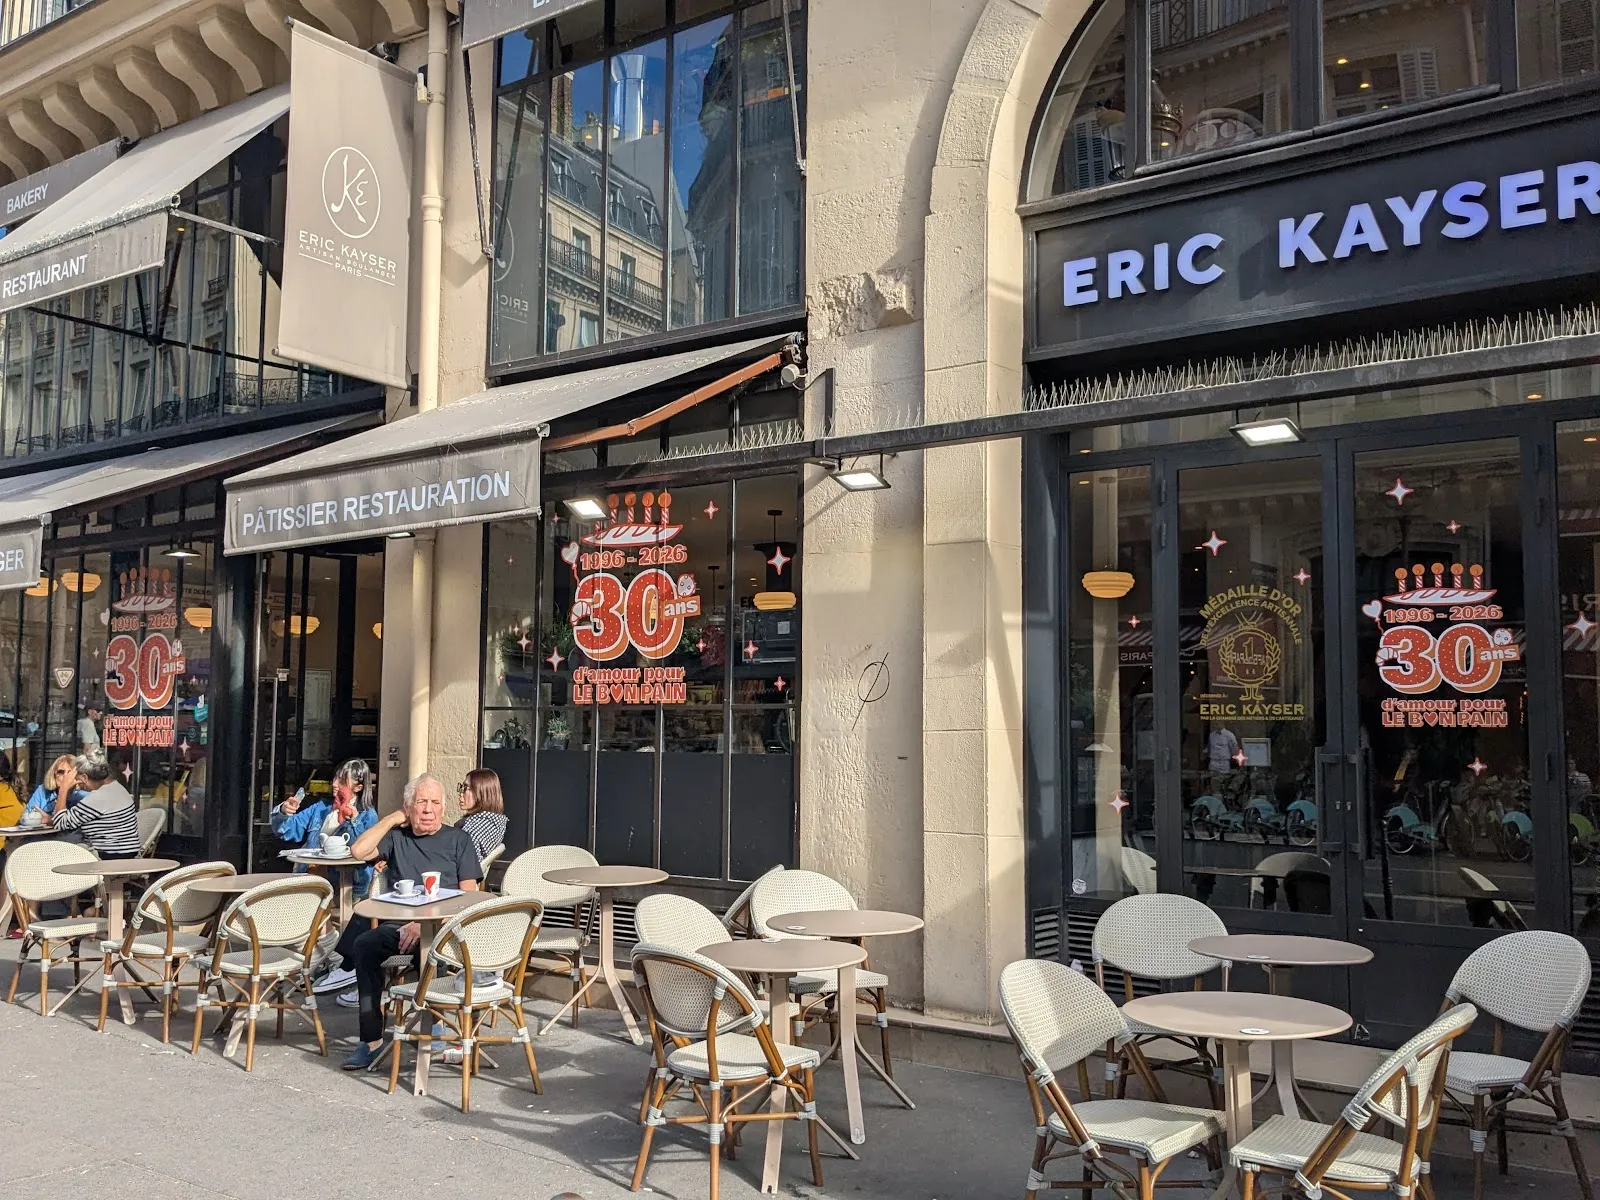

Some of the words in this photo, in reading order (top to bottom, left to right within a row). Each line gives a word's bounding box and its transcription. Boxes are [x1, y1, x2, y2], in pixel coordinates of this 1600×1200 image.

[7, 183, 49, 214] BAKERY
[1062, 232, 1226, 307] ERIC
[1278, 160, 1600, 268] KAYSER
[299, 230, 335, 252] ERIC
[341, 244, 397, 273] KAYSER
[299, 243, 341, 261] ARTISAN
[346, 259, 396, 280] BOULANGER
[2, 254, 88, 298] RESTAURANT
[335, 263, 362, 277] PARIS
[242, 500, 338, 536] PÂTISSIER
[343, 470, 510, 522] RESTAURATION
[579, 548, 626, 571] 1996
[638, 544, 688, 565] 2026
[573, 568, 685, 661] 30
[664, 598, 699, 617] ans
[1199, 584, 1268, 619] MÉDAILLE
[1384, 608, 1434, 623] 1996
[1449, 604, 1503, 621] 2026
[111, 616, 139, 632] 1996
[148, 613, 177, 629] 2026
[1260, 600, 1303, 645] ARTISANALE
[104, 633, 174, 710] 30
[162, 660, 184, 674] ans
[1379, 622, 1502, 694] 30
[1480, 648, 1517, 661] ans
[643, 666, 686, 685] pour
[573, 684, 594, 703] LE
[640, 682, 687, 704] PAIN
[1460, 699, 1507, 712] pour
[148, 715, 174, 731] pour
[1200, 703, 1237, 715] ERIC
[1243, 703, 1304, 715] KAYSER
[1382, 712, 1405, 727] LE
[1457, 711, 1508, 728] PAIN
[103, 729, 117, 745] LE
[145, 729, 175, 747] PAIN
